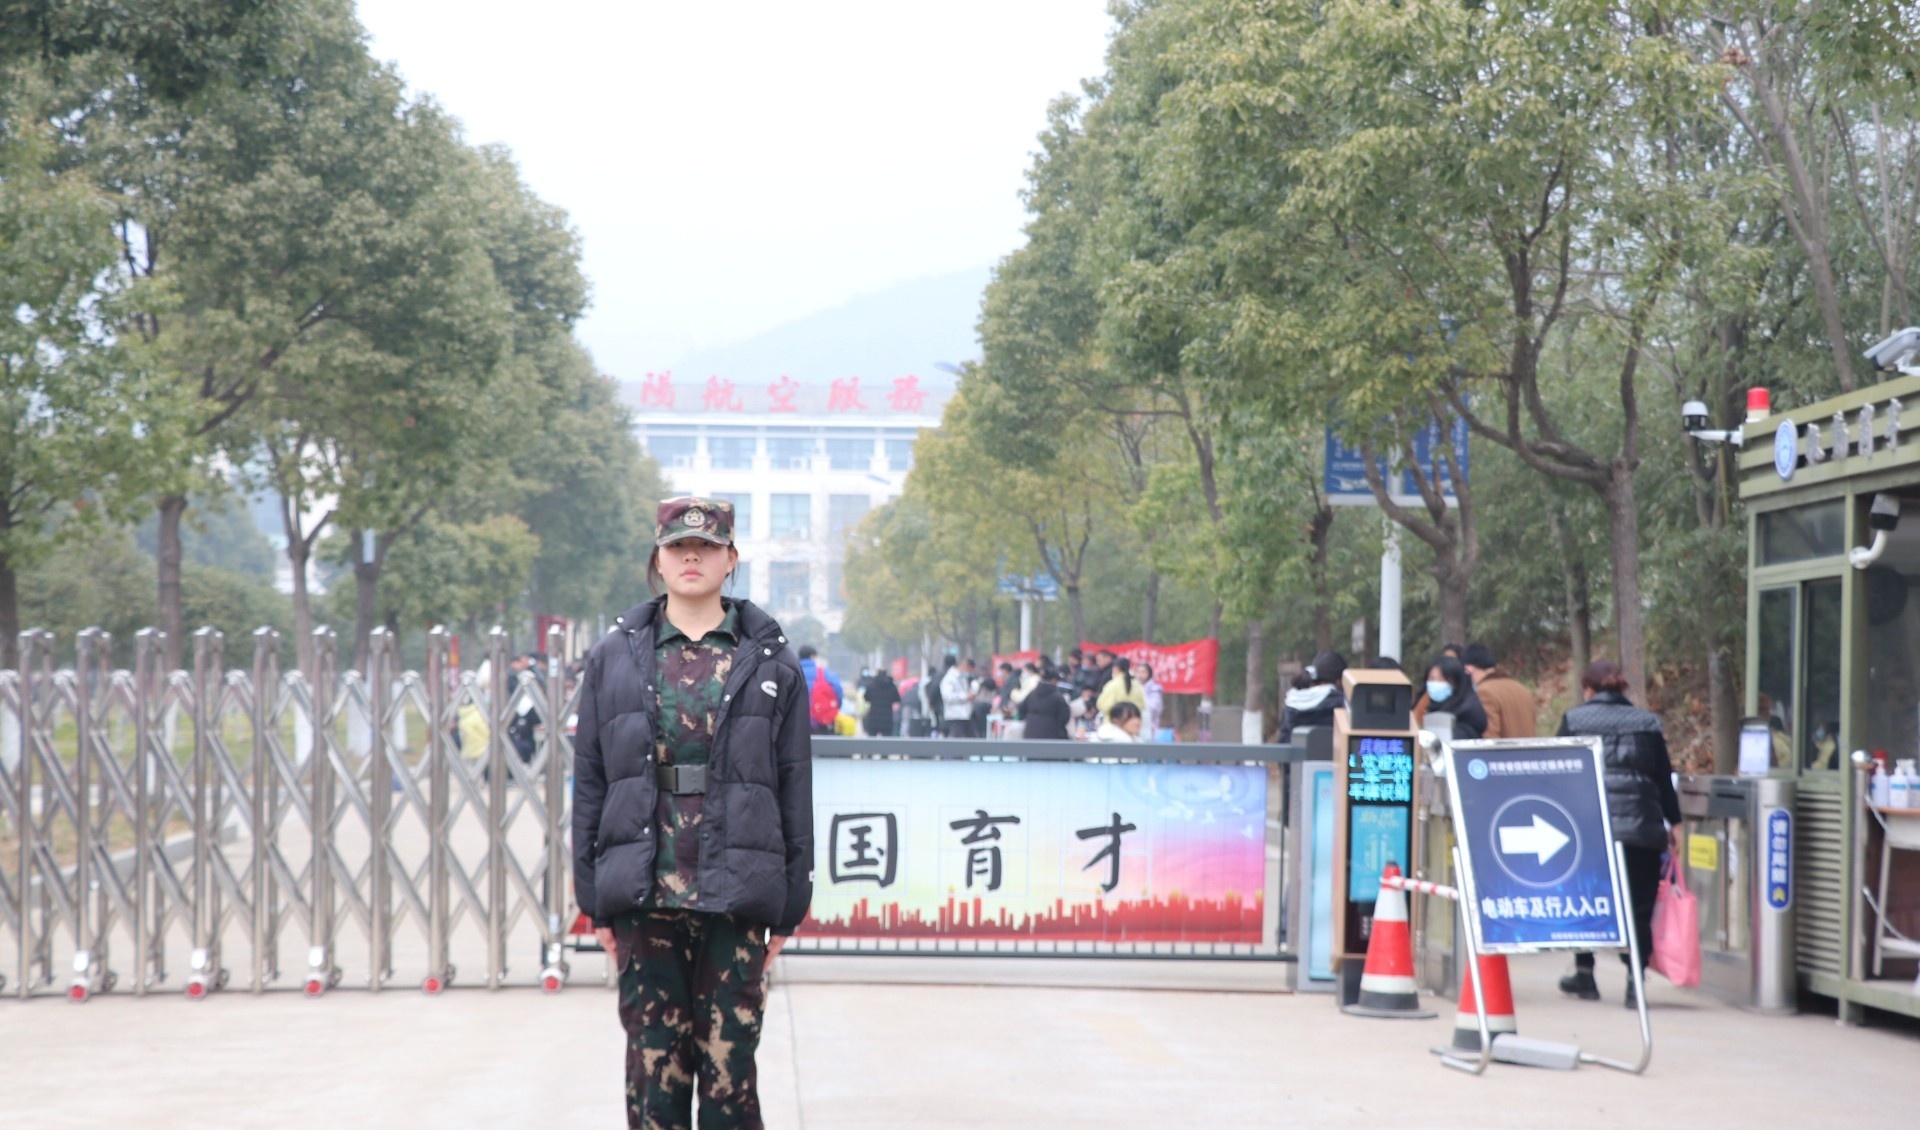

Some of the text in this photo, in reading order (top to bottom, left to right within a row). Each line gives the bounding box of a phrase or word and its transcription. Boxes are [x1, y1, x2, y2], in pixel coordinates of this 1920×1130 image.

[1481, 896, 1611, 919] 电动车及行人入口
